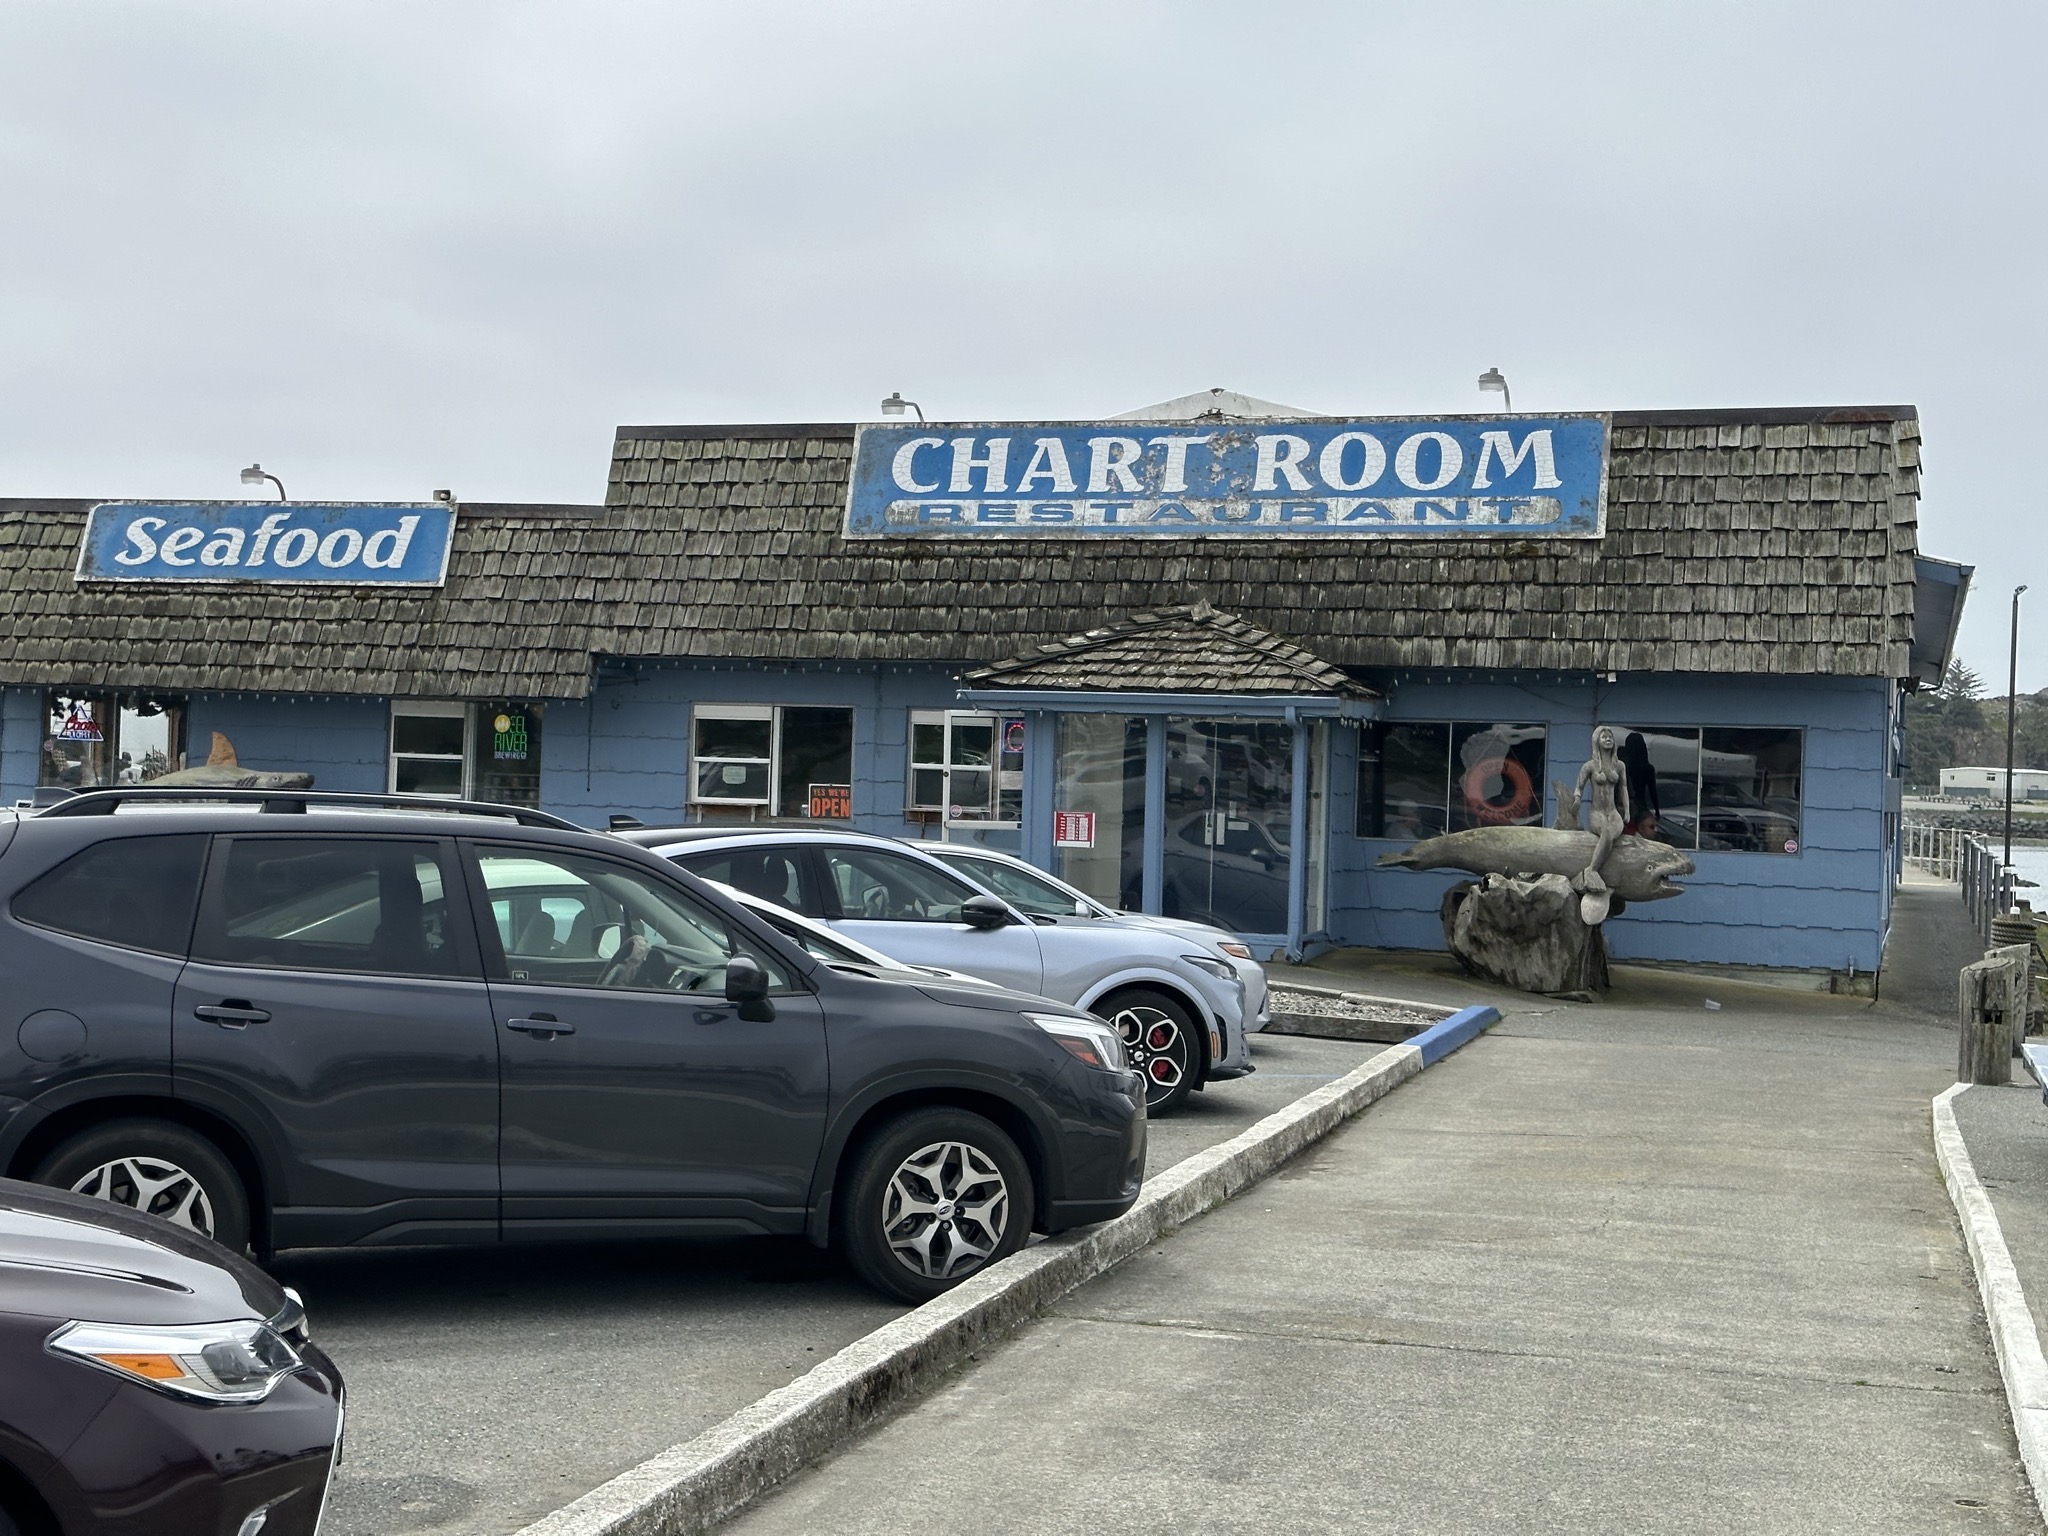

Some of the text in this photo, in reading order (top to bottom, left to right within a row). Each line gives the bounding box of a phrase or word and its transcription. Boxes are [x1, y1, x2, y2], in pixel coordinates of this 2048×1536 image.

[891, 429, 1563, 494] CHART ROOM
[918, 500, 1531, 524] RESTAURANT
[114, 512, 421, 569] Seafood
[494, 733, 527, 752] RIVER
[811, 797, 850, 817] OPEN
